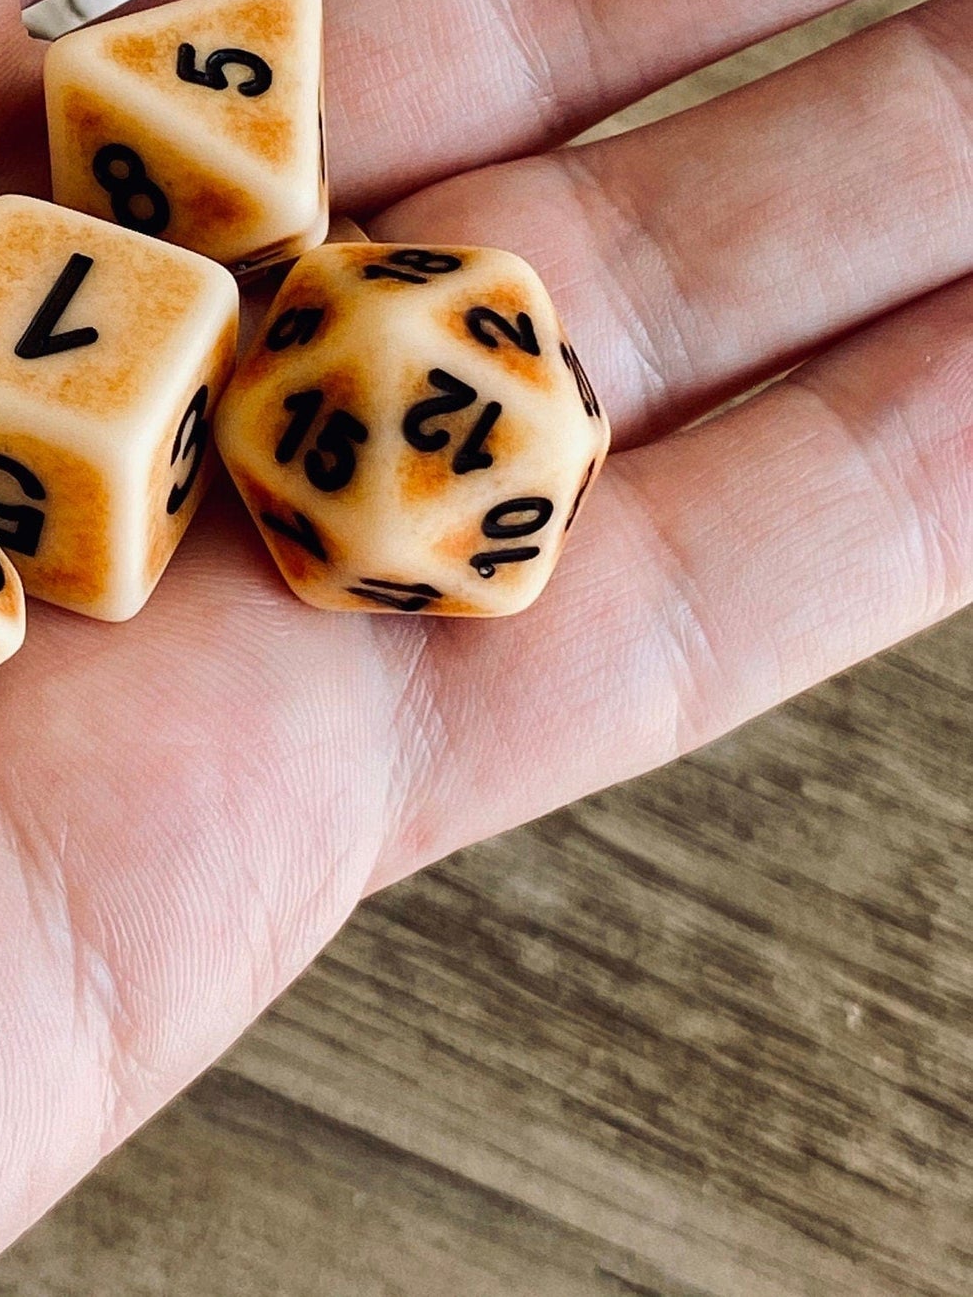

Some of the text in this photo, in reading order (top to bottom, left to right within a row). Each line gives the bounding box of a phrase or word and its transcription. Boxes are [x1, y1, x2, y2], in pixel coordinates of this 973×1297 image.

[176, 42, 273, 96] 5
[92, 143, 171, 236] 8
[465, 305, 542, 357] 2
[166, 385, 210, 516] 3
[274, 388, 370, 493] 15
[401, 367, 504, 476] 12
[468, 496, 555, 579] 10
